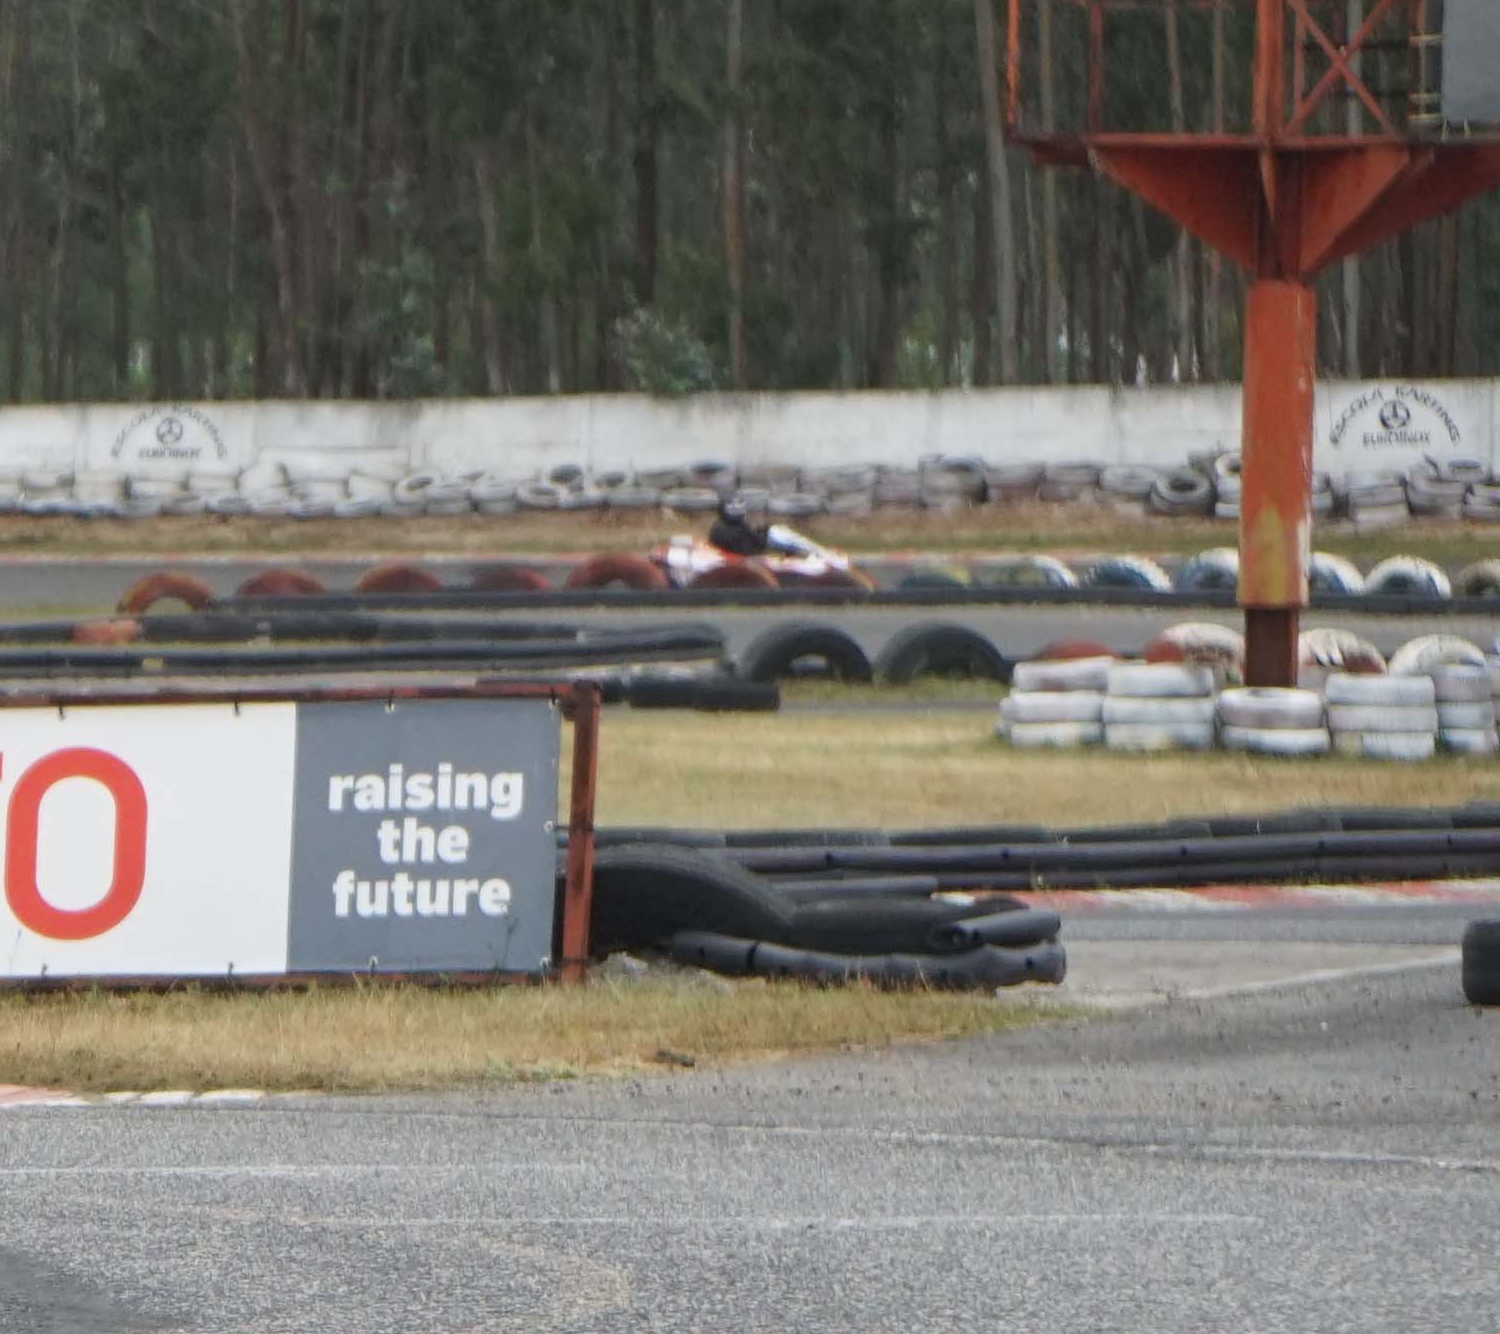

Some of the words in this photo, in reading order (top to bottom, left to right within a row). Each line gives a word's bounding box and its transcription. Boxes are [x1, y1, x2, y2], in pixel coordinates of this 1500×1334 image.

[328, 762, 524, 821] raising
[377, 817, 470, 864] the
[332, 870, 512, 918] future
